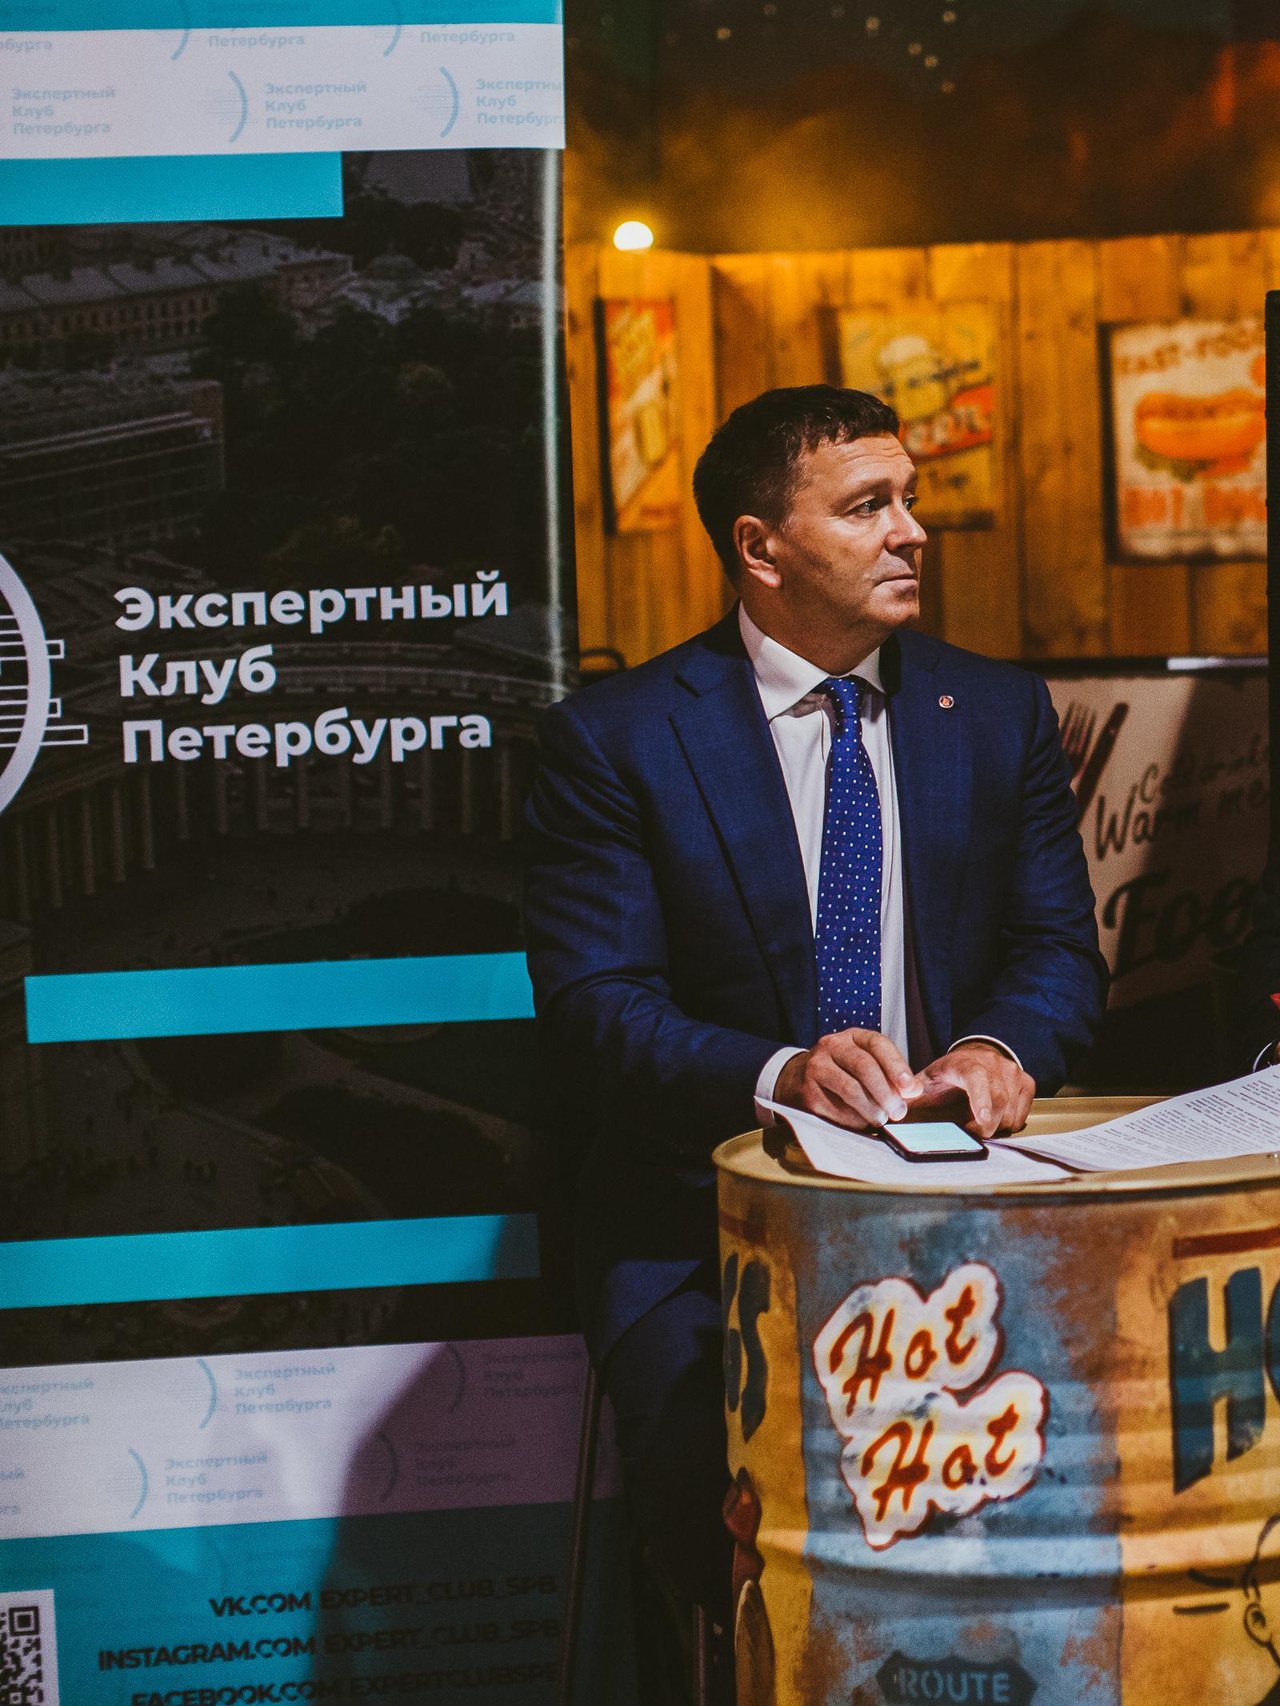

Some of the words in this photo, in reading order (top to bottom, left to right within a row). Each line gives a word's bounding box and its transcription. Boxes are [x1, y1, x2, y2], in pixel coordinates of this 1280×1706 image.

[0, 37, 53, 53] бурга
[208, 34, 305, 49] Петербурга
[420, 30, 515, 45] Петербурга
[12, 86, 115, 102] Экспертный
[264, 82, 367, 97] Экспертный
[265, 99, 306, 114] Клуб
[476, 95, 517, 110] Клуб
[12, 105, 55, 119] Клуб
[12, 120, 111, 137] Петербурга
[265, 114, 364, 131] Петербурга
[113, 569, 509, 635] Экспертный
[118, 643, 277, 706] Клуб
[122, 706, 492, 768] Петербурга
[829, 1284, 977, 1418] Hot
[234, 1363, 335, 1381] Экспертный
[234, 1382, 276, 1399] Клуб
[235, 1399, 332, 1416] Петербурга
[165, 1453, 268, 1470] Экспертный
[860, 1403, 1020, 1522] Hot
[165, 1473, 207, 1488] Клуб
[166, 1488, 264, 1505] Петербурга
[208, 1591, 312, 1618] VK.COM
[319, 1575, 556, 1610] EXPERT_CLUB_SPB
[98, 1636, 315, 1672] INSTAGRAM.COM
[323, 1618, 560, 1655] EXPERT_CLUB_SPB
[131, 1679, 341, 1706] FACEBOOK.COM
[898, 1667, 1012, 1703] ROUTE
